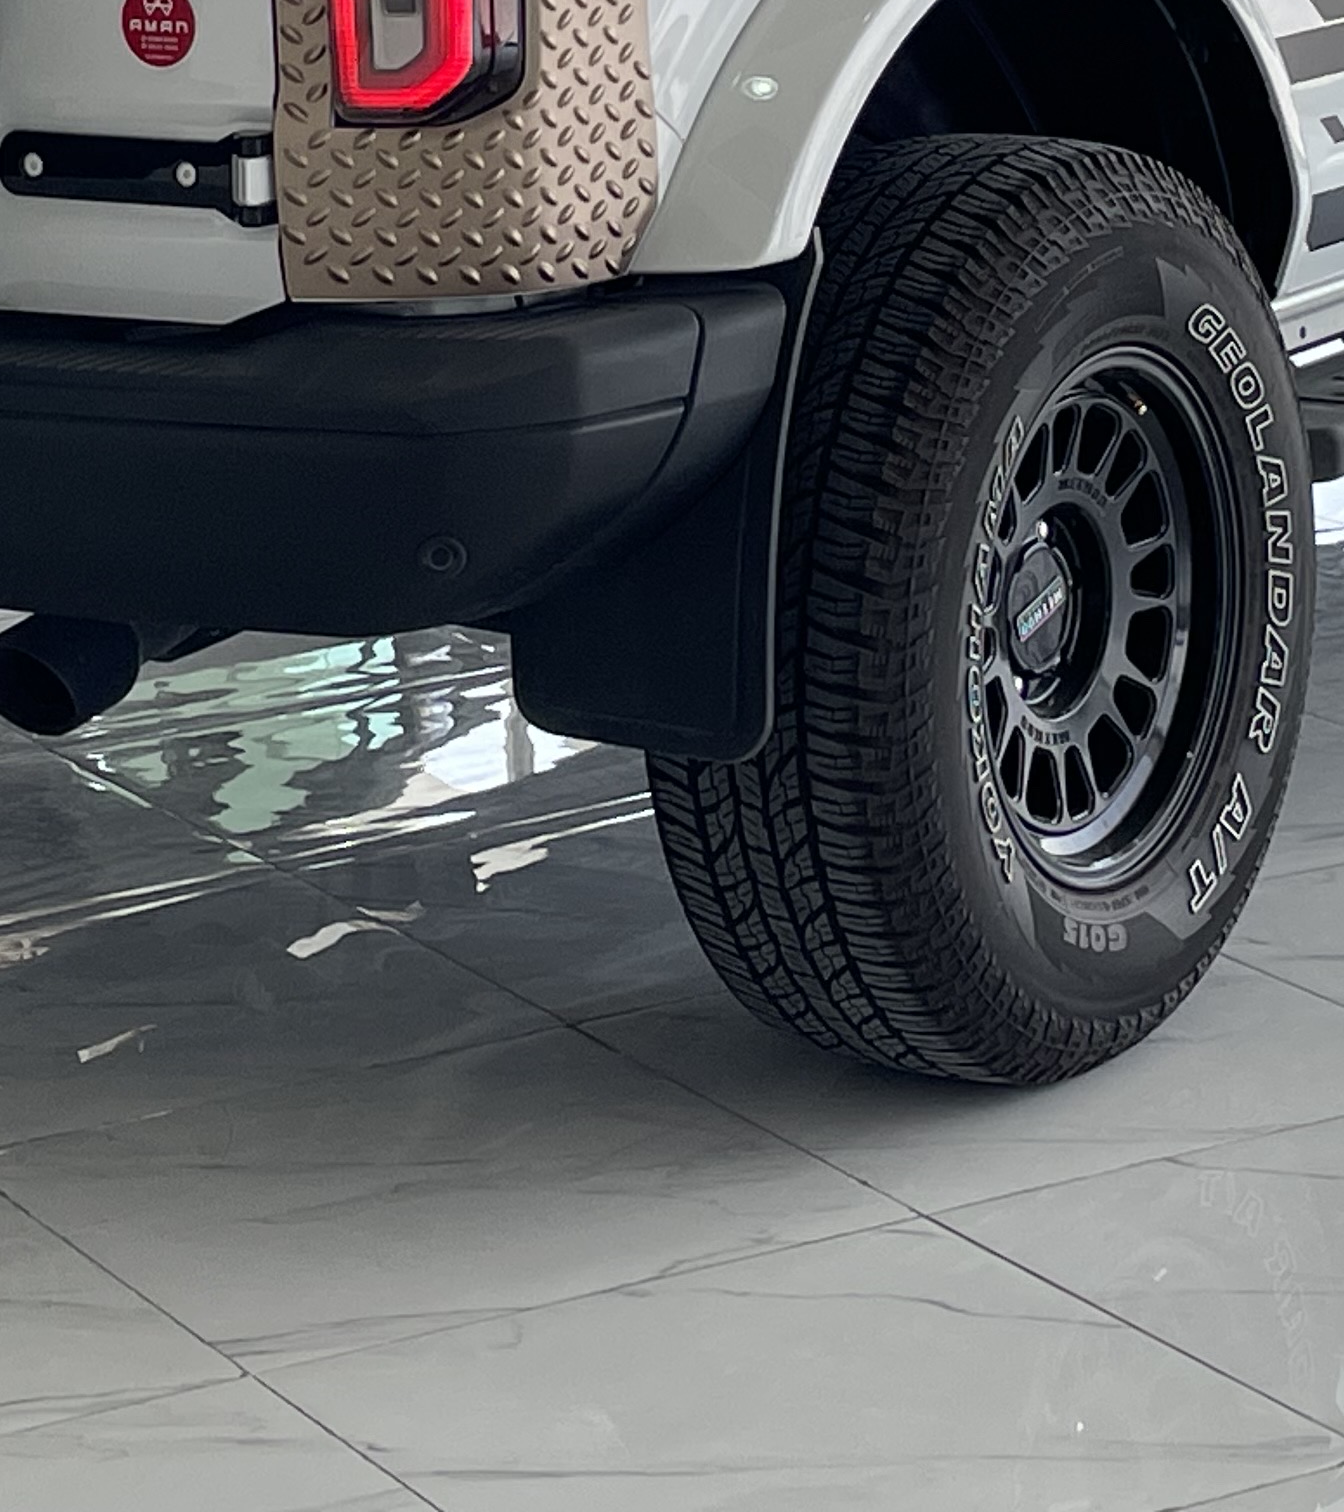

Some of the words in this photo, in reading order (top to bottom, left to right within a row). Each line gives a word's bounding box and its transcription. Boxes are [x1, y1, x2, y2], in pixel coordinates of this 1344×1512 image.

[1187, 304, 1294, 755] GEOLANDAR
[1188, 772, 1254, 915] A/T
[1062, 916, 1128, 954] G015
